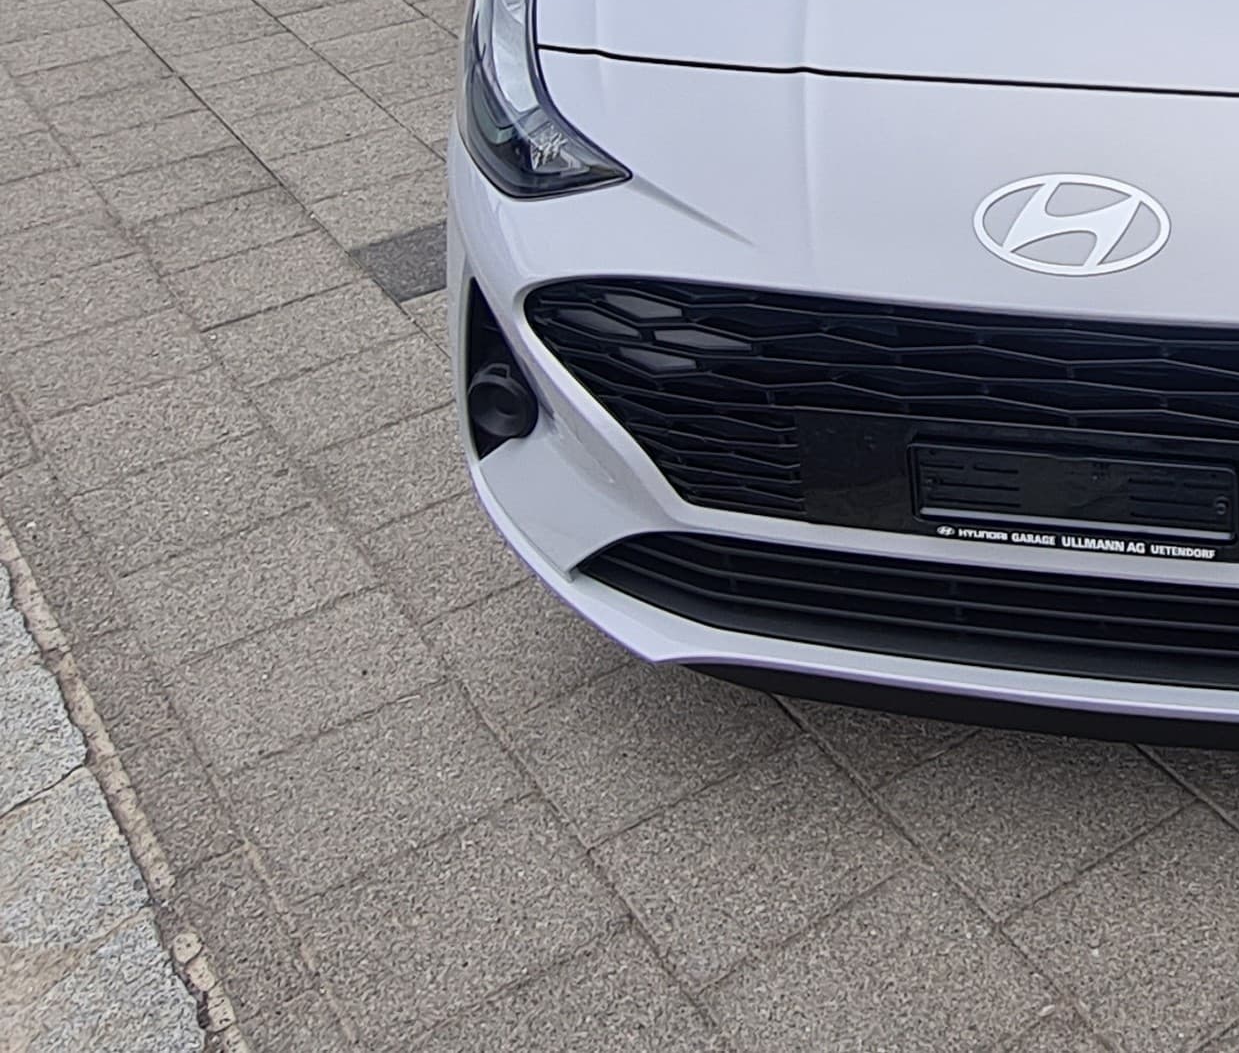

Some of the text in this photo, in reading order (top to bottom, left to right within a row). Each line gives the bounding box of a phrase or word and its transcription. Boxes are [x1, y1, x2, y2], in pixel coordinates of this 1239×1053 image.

[958, 528, 1216, 559] HYUNDAI GARAGE ULLMANN AG UETENDORF
